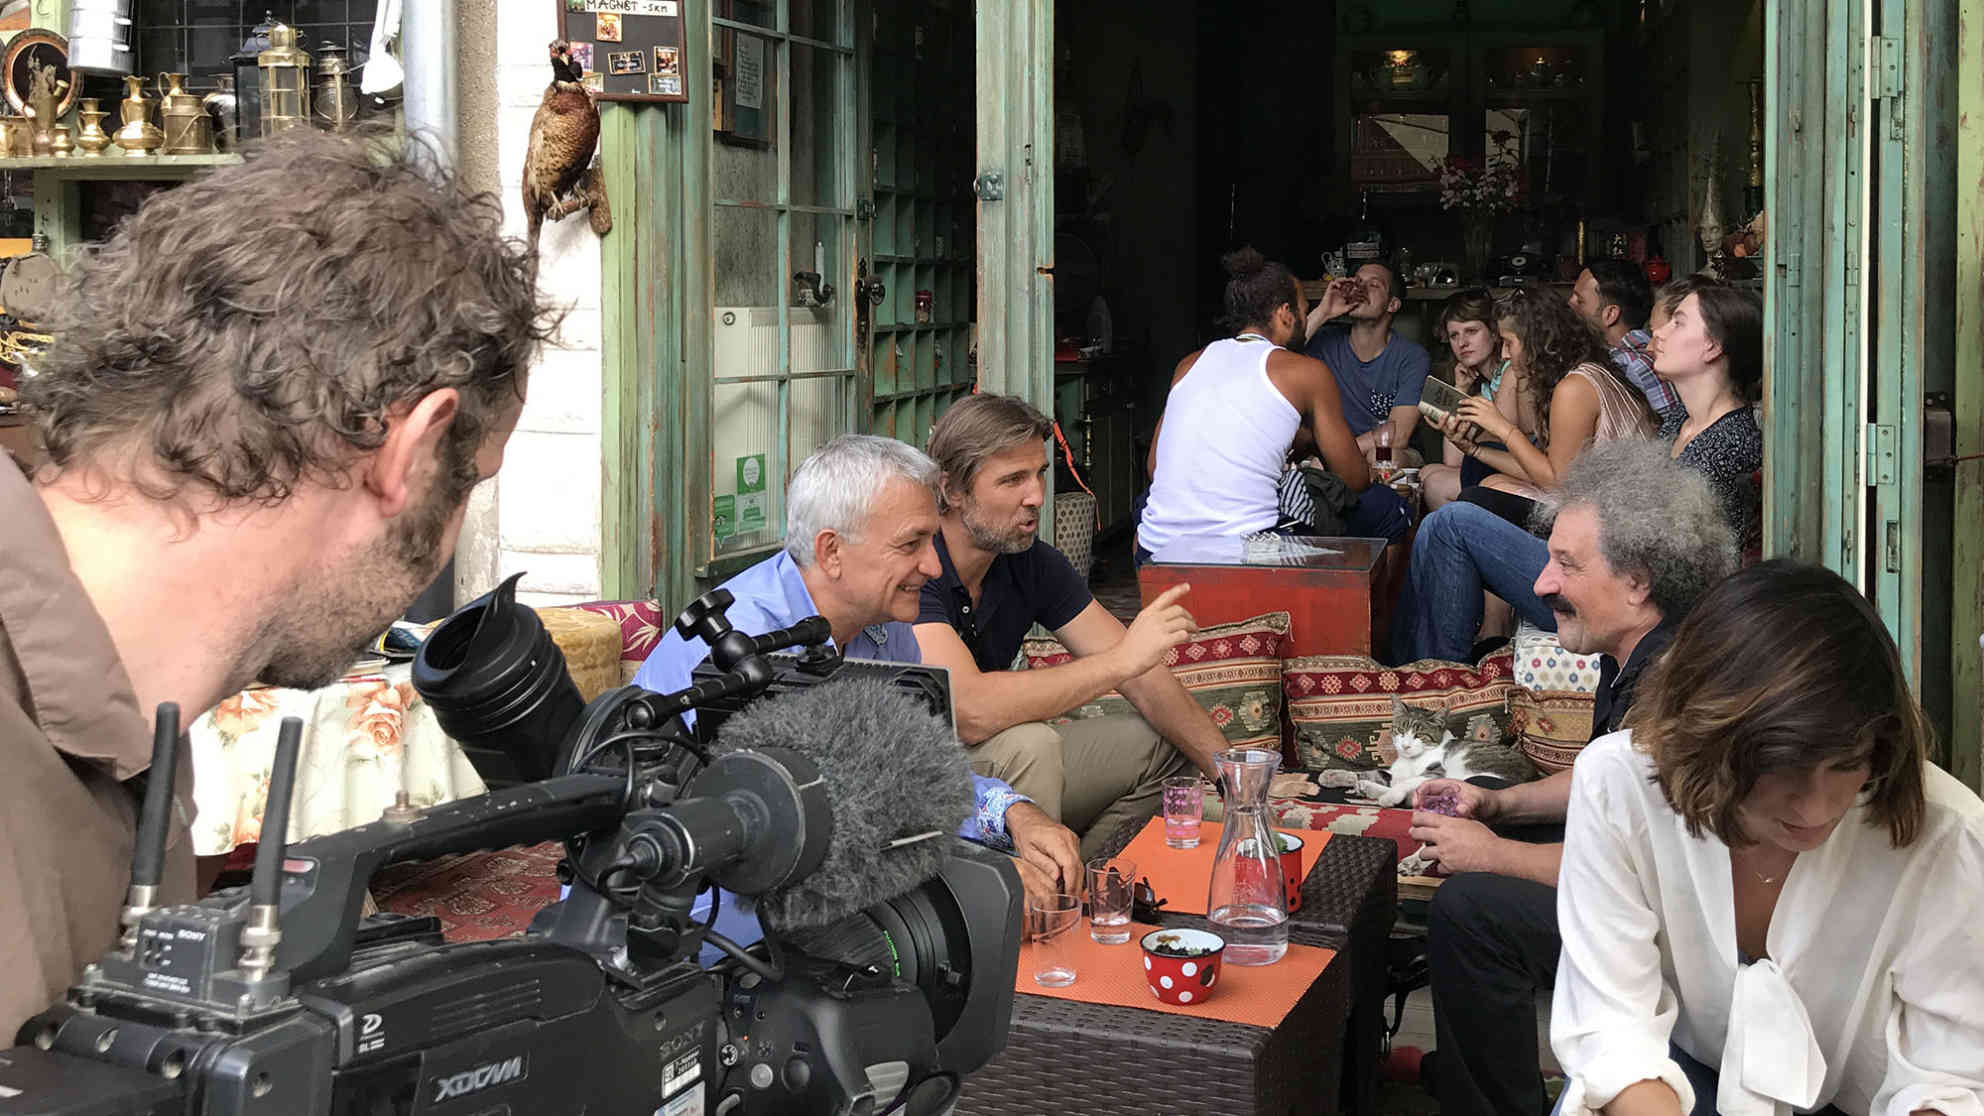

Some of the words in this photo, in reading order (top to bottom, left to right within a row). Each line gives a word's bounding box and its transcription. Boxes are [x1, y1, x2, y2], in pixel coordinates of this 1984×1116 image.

[178, 929, 206, 942] SONY
[660, 1020, 704, 1058] SONY
[434, 1056, 522, 1102] XDCAM
